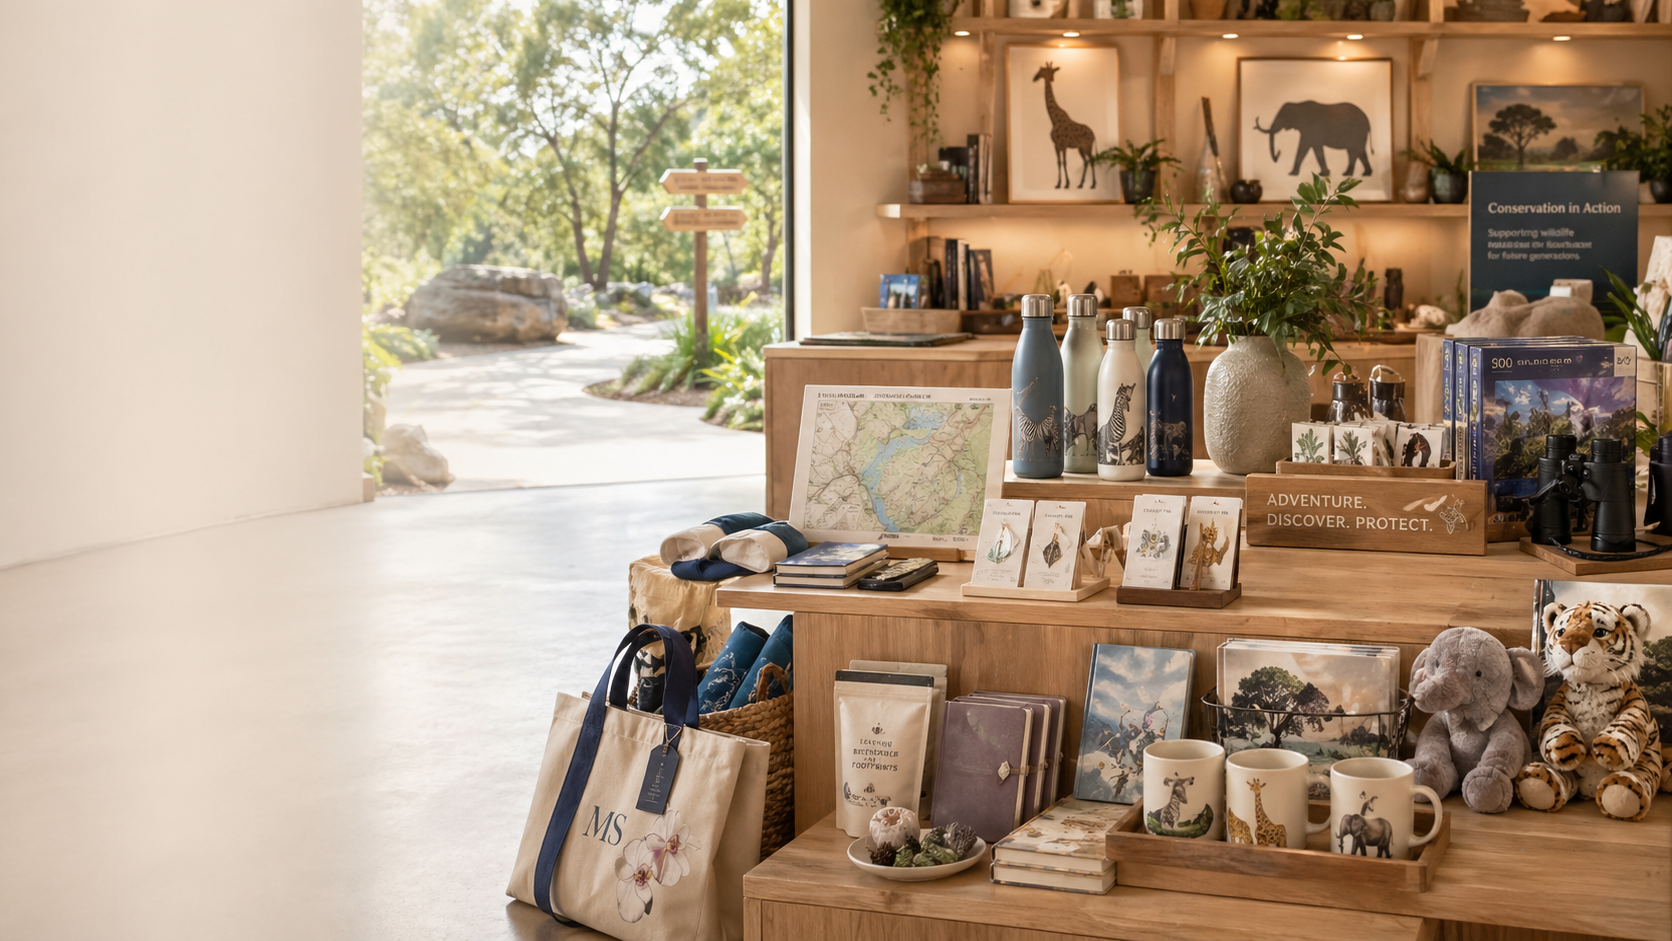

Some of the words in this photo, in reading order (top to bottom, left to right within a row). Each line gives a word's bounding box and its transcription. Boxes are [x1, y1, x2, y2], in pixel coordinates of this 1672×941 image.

[1487, 202, 1566, 214] Conservation
[1568, 202, 1580, 213] in
[1582, 202, 1622, 214] Action
[1267, 493, 1367, 510] ADVENTURE.
[1267, 513, 1350, 529] DISCOVER.
[1356, 516, 1433, 532] PROTECT.
[582, 804, 627, 846] MS
